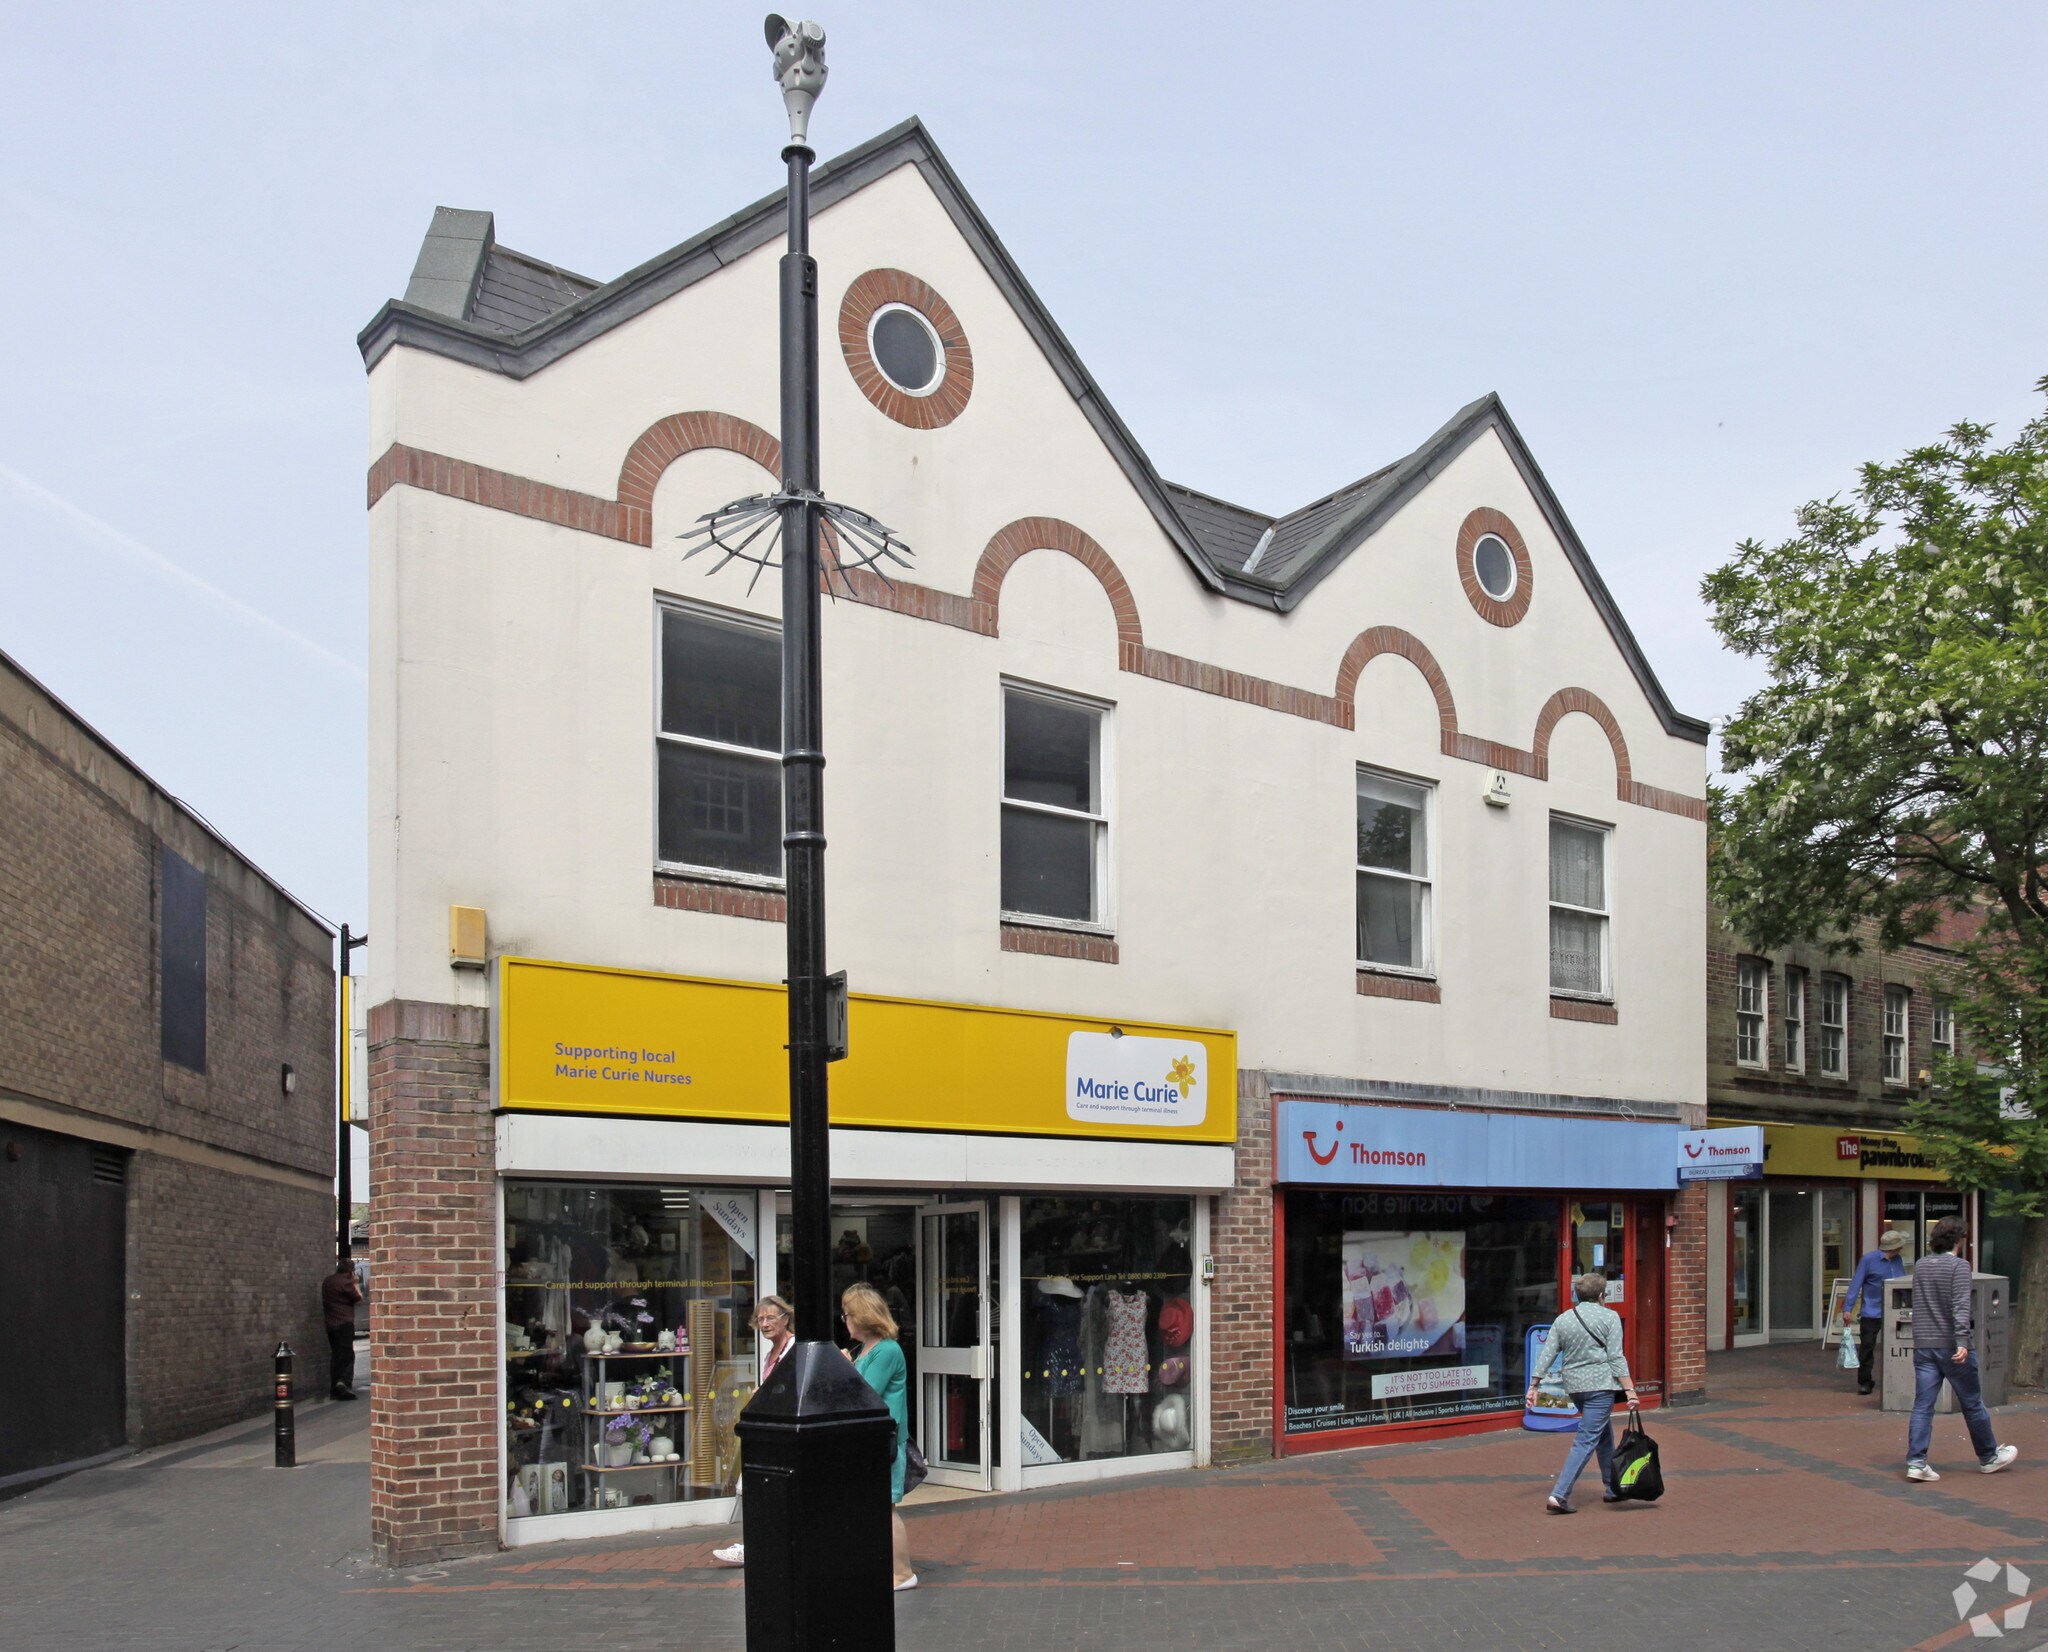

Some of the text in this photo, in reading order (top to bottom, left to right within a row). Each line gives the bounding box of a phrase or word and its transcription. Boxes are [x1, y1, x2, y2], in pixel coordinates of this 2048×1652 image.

[555, 1042, 675, 1064] Supporting local
[555, 1063, 692, 1085] Marie Curie Nurses
[1076, 1077, 1179, 1104] Marie Curie
[1100, 1104, 1120, 1112] support
[1120, 1104, 1141, 1114] through
[1142, 1106, 1163, 1114] terminal
[1163, 1107, 1179, 1115] illness
[1350, 1143, 1426, 1166] Thomson
[1708, 1147, 1750, 1156] Thomson
[1840, 1140, 1858, 1156] The
[727, 1199, 749, 1224] Open
[712, 1201, 747, 1239] Sundays
[545, 1278, 714, 1291] Care and support through terminal illness
[1080, 1273, 1104, 1282] Support
[1350, 1332, 1361, 1342] Say
[1361, 1332, 1373, 1341] yes
[1350, 1338, 1430, 1353] Turkish delights
[1391, 1368, 1473, 1384] IT'S NOT TOO LATE TO
[1384, 1377, 1478, 1395] SAY YES TO SUMMER 2016
[1288, 1402, 1345, 1416] Discover your smile
[1288, 1420, 1312, 1431] Beaches
[1316, 1418, 1336, 1428] Cruises
[1341, 1417, 1354, 1425] Long
[1355, 1414, 1368, 1423] Haul
[1371, 1412, 1389, 1422] Family
[1393, 1411, 1402, 1420] UK
[1438, 1405, 1454, 1415] Sports
[1460, 1402, 1481, 1411] Activities
[1485, 1400, 1501, 1410] Florida
[1504, 1397, 1519, 1407] Adults
